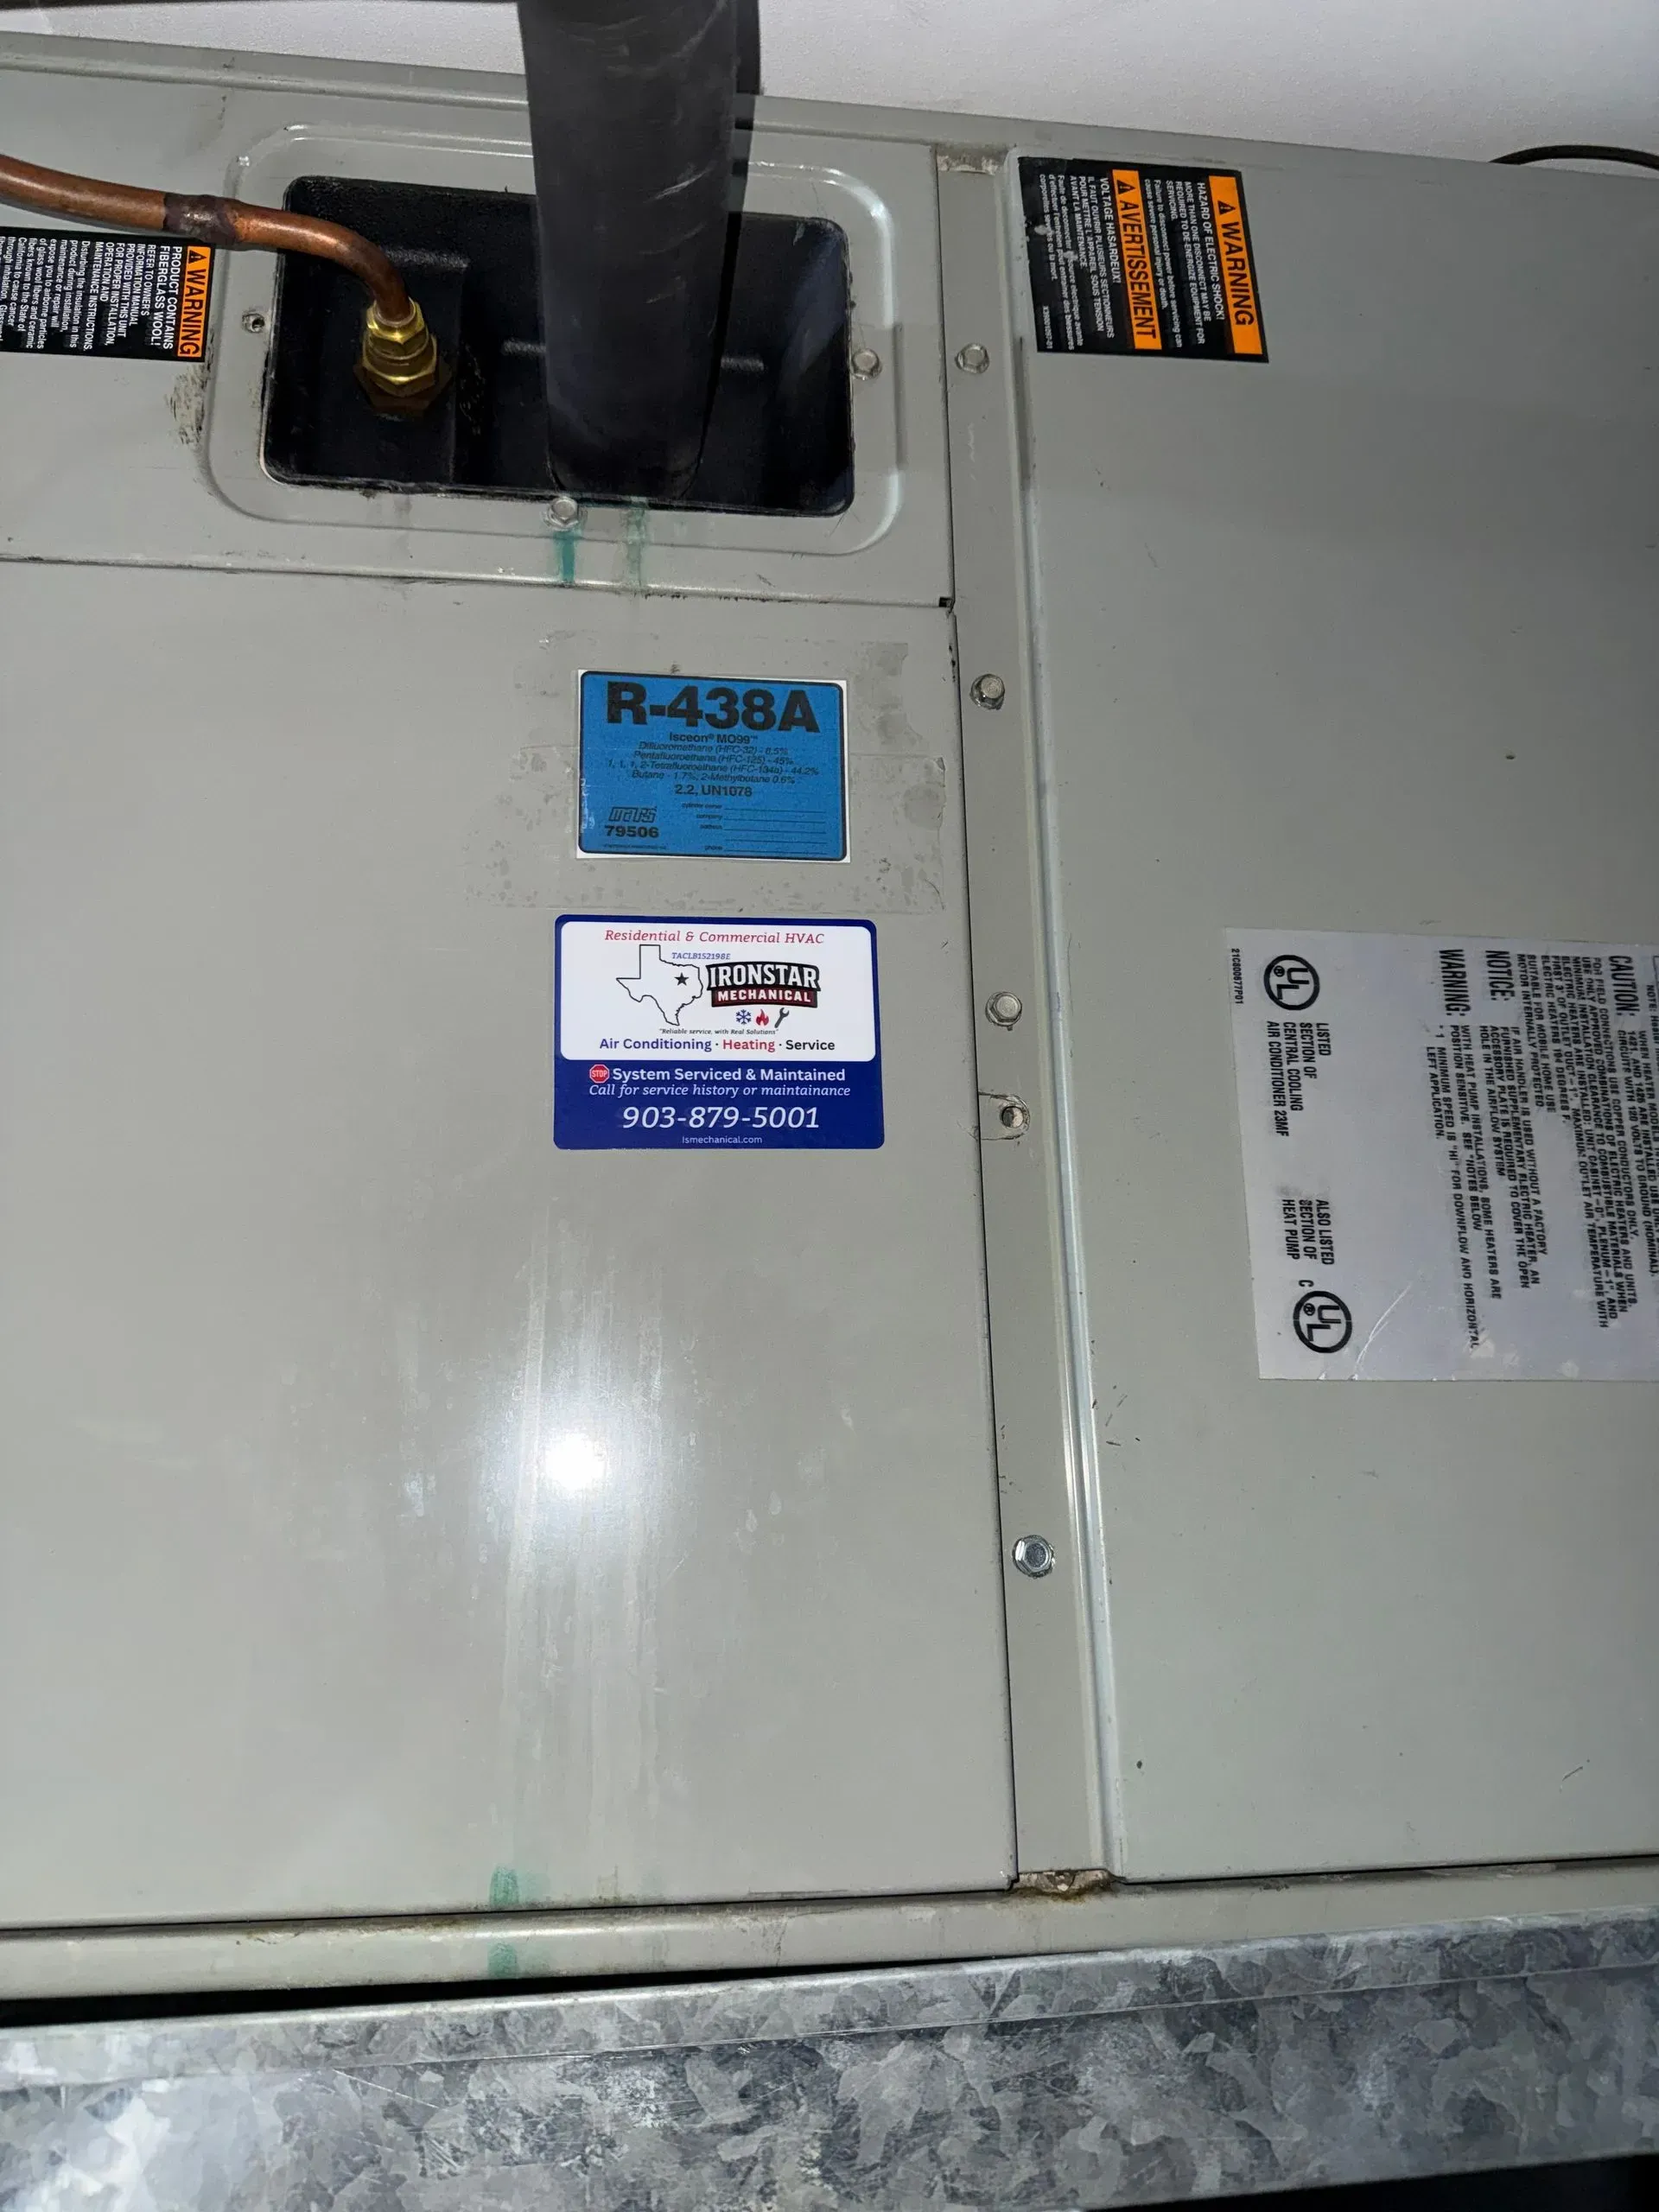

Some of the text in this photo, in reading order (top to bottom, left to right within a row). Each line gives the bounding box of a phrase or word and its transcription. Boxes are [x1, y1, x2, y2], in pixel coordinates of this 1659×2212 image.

[1089, 184, 1097, 204] FAUT
[1090, 205, 1101, 233] OUVRIR
[1147, 200, 1155, 223] severe
[1166, 180, 1178, 220] SERVICING.
[1095, 234, 1107, 276] PLUSIEURS
[1099, 177, 1121, 283] VOLTAGE HASARDEUX!
[1149, 224, 1161, 255] personal
[1158, 212, 1170, 251] disconnect
[1184, 181, 1211, 321] MORE THAN ONE DISCONNECT MAY BE
[1197, 182, 1224, 319] HAZARD OF ELECTRIC SHOCK!
[50, 238, 67, 327] maintenance or repair will
[75, 240, 90, 276] Disturbing
[76, 277, 86, 289] the
[99, 241, 114, 302] OPERATION AND
[140, 244, 156, 315] REFER TO OWNER'S
[1119, 200, 1156, 339] AVERTISSEMENT
[1154, 256, 1162, 276] injury
[1158, 277, 1164, 286] or
[1162, 251, 1172, 274] power
[1175, 181, 1205, 343] REQUIRED TO DE-ENERGIZE EQUIPMENT FOR
[1220, 220, 1255, 326] WARNING
[60, 238, 78, 332] product during installation,
[73, 289, 85, 324] insulation
[83, 241, 104, 351] MAINTENANCE INSTRUCTIONS.
[105, 242, 124, 345] FOR PROPER INSTALLATION,
[117, 243, 136, 337] PROVIDED WITH THIS UNIT
[128, 243, 145, 326] INFORMATION MANUAL
[150, 245, 170, 345] FIBERGLASS WOOL!
[162, 245, 182, 349] PRODUCT CONTAINS
[1100, 278, 1114, 338] SECTIONNEURS
[1159, 287, 1168, 309] death.
[1166, 275, 1175, 298] before
[179, 267, 207, 354] WARNING
[1170, 299, 1179, 333] servicing
[69, 334, 79, 347] this
[607, 680, 820, 734] R-438A
[674, 784, 753, 798] 2.2, UN1078
[604, 824, 659, 839] 79506
[604, 929, 824, 944] Residential & Commercial HVAC
[709, 963, 818, 989] IRONSTAR
[717, 988, 811, 1002] MECHANICAL
[1439, 949, 1471, 1015] WARNING:
[1485, 950, 1515, 1001] NOTICE:
[1608, 955, 1639, 1015] CAUTION:
[599, 1038, 836, 1053] Air Conditioning Heating Service
[1299, 1022, 1316, 1078] SECTION OF
[1315, 1022, 1331, 1055] LISTED
[1450, 1025, 1464, 1068] POSITION
[1526, 954, 1555, 1112] SUITABLE FOR MOBILE HOME USE
[590, 1068, 608, 1079] STOP
[612, 1067, 846, 1083] System Serviced & Maintained
[1267, 1020, 1288, 1136] AIR CONDITIONER 23MF
[1282, 1021, 1303, 1110] CENTRAL COOLING
[588, 1084, 851, 1099] Call for service history or maintainance
[622, 1106, 819, 1128] 903-879-5001
[1455, 1072, 1470, 1124] SENSITIVE.
[1478, 1025, 1505, 1176] HOLE IN THE AIRFLOW SYSTEM
[1460, 1025, 1501, 1298] WITH HEAT PUMP INSTALLATIONS, SOME HEATERS ARE
[1462, 1132, 1472, 1149] SEE
[1281, 1198, 1300, 1259] HEAT PUMP
[1298, 1199, 1317, 1259] SECTION OF
[1315, 1198, 1334, 1264] ALSO LISTED
[1469, 1195, 1482, 1230] BELOW
